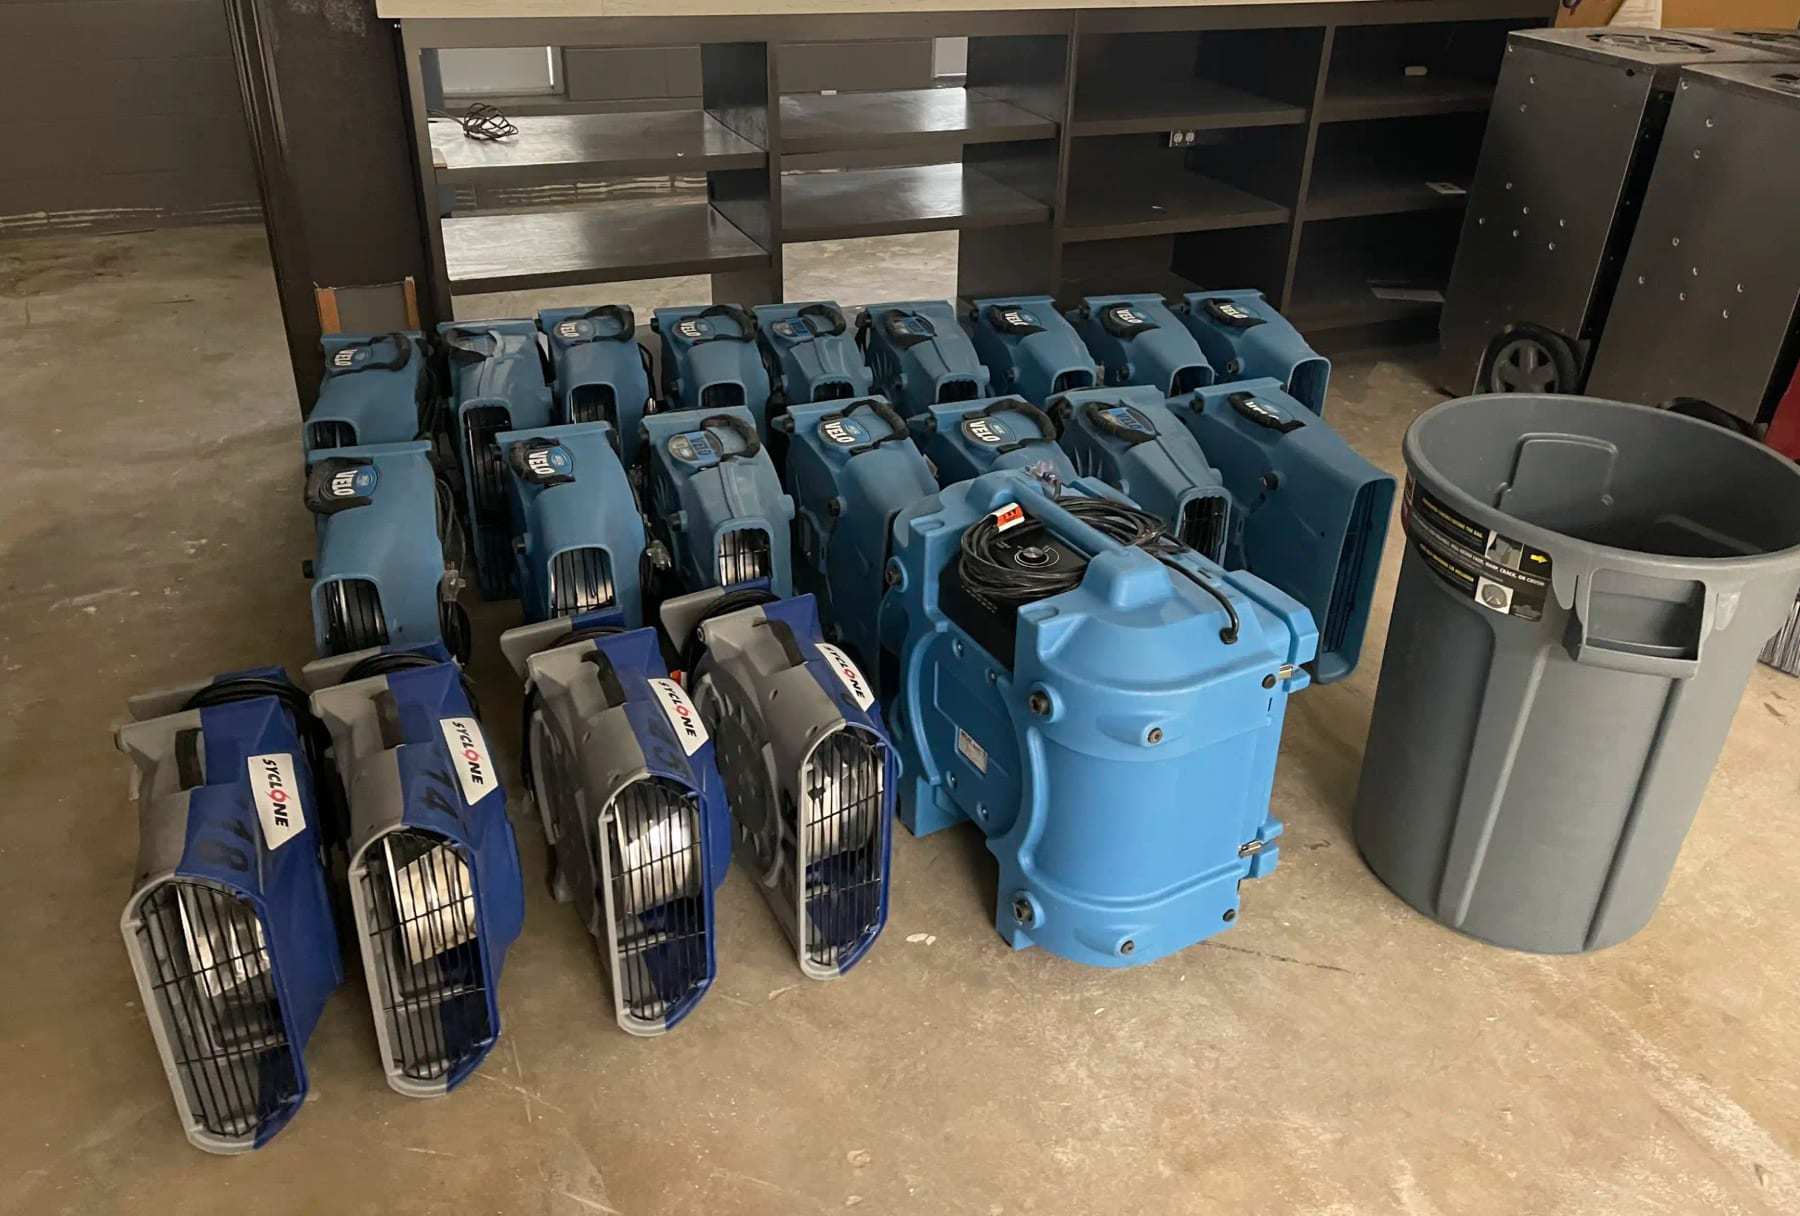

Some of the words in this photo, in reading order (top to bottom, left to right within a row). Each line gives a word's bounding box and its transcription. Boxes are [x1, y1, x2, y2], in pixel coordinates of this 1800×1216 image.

[560, 322, 580, 337] VELO
[680, 321, 702, 337] VELO
[334, 348, 358, 366] VELO
[824, 421, 855, 443] VELO
[969, 420, 1001, 442] VELO
[528, 450, 555, 475] VELO
[332, 470, 358, 496] VELO
[658, 680, 697, 737] SYCLONE
[452, 720, 484, 785] SYCLONE
[262, 758, 290, 828] SYCLONE
